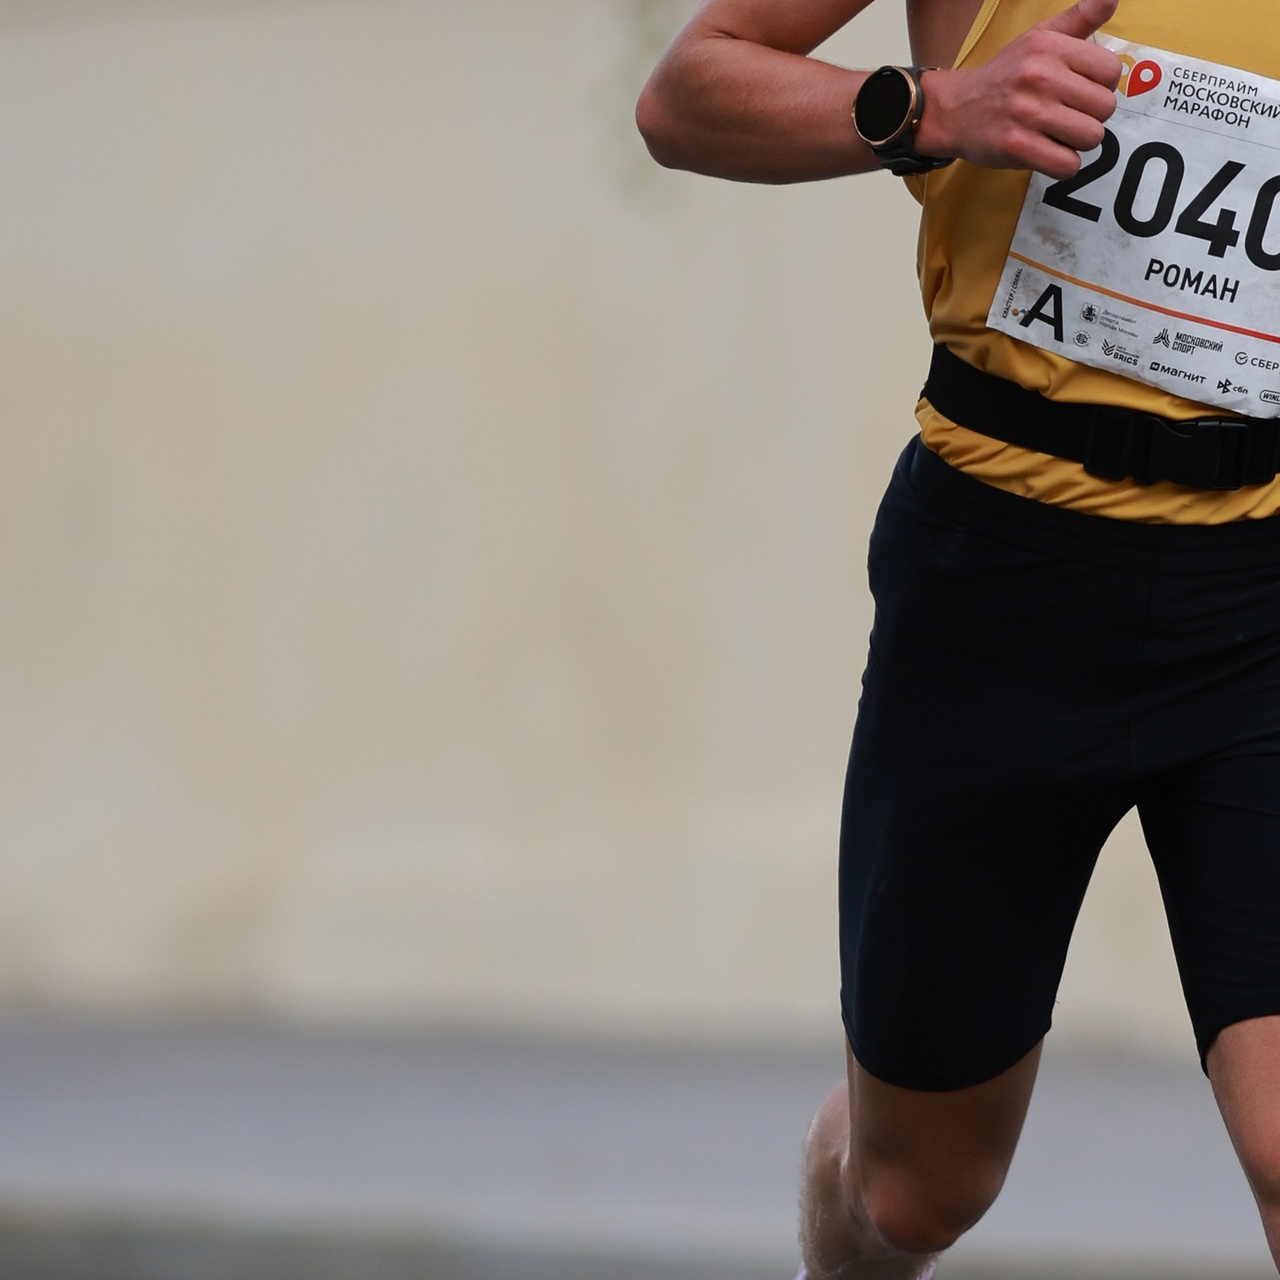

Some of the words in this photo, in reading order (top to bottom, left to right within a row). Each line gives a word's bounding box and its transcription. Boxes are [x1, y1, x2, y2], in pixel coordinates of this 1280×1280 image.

[1173, 67, 1259, 97] СБЕРПРАЙМ
[1163, 96, 1251, 129] МАРАФОН
[1144, 258, 1240, 304] РОМАН
[1171, 342, 1196, 355] СПОРТ
[1174, 331, 1223, 352] МОСКОВСКИЙ
[1113, 352, 1139, 366] BRICS
[1250, 357, 1280, 371] СБЕР
